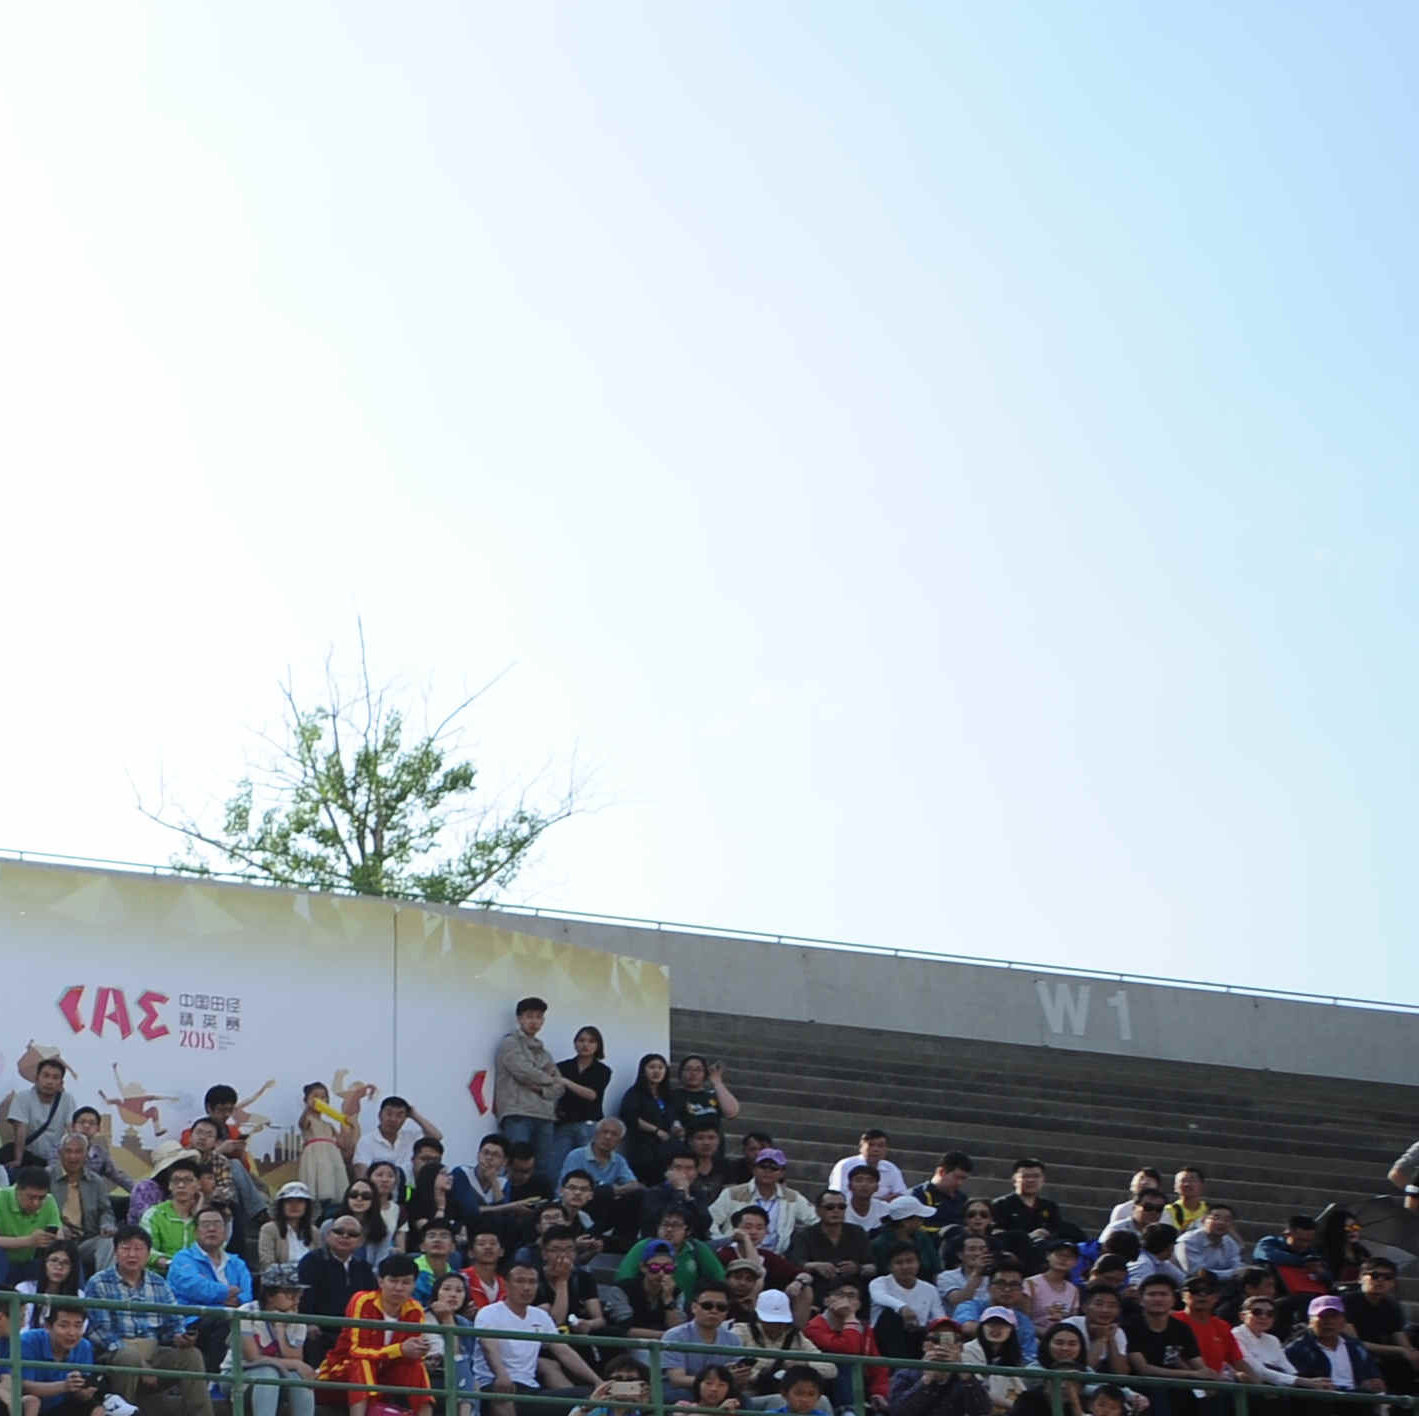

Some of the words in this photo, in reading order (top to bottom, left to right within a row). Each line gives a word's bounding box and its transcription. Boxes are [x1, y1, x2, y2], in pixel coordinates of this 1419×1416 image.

[179, 993, 241, 1013] 中国田径
[179, 1011, 240, 1032] 精英赛
[179, 1030, 215, 1050] 2015
